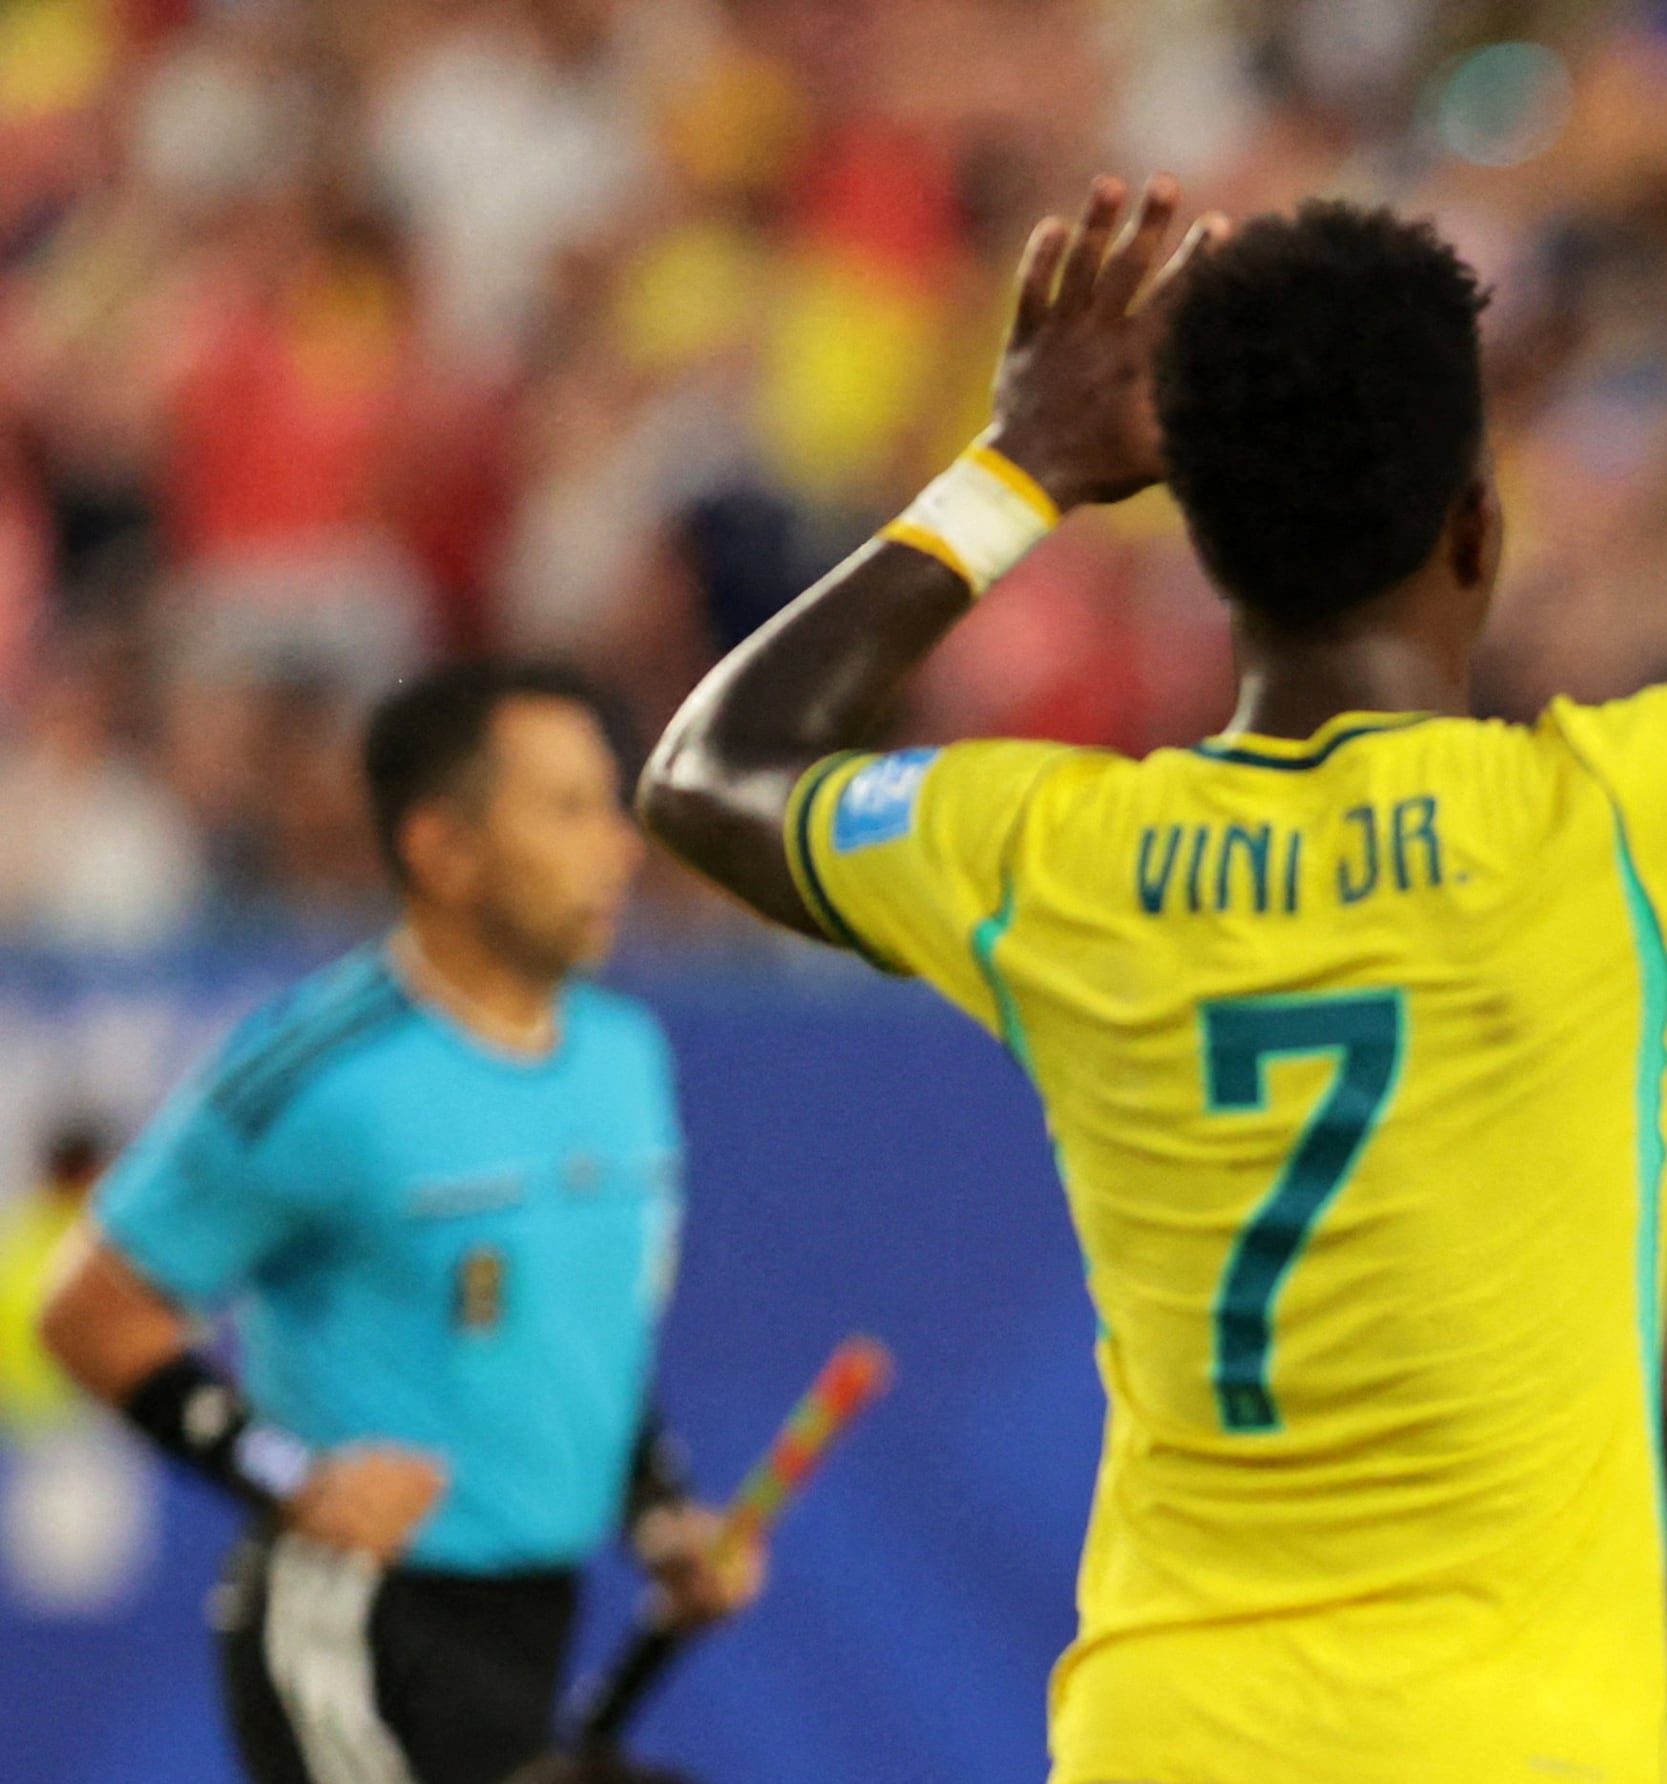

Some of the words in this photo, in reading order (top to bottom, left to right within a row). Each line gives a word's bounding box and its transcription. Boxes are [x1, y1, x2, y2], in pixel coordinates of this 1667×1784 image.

[1138, 822, 1301, 913] VINI
[1337, 795, 1470, 905] JR.
[1196, 985, 1405, 1434] 7
